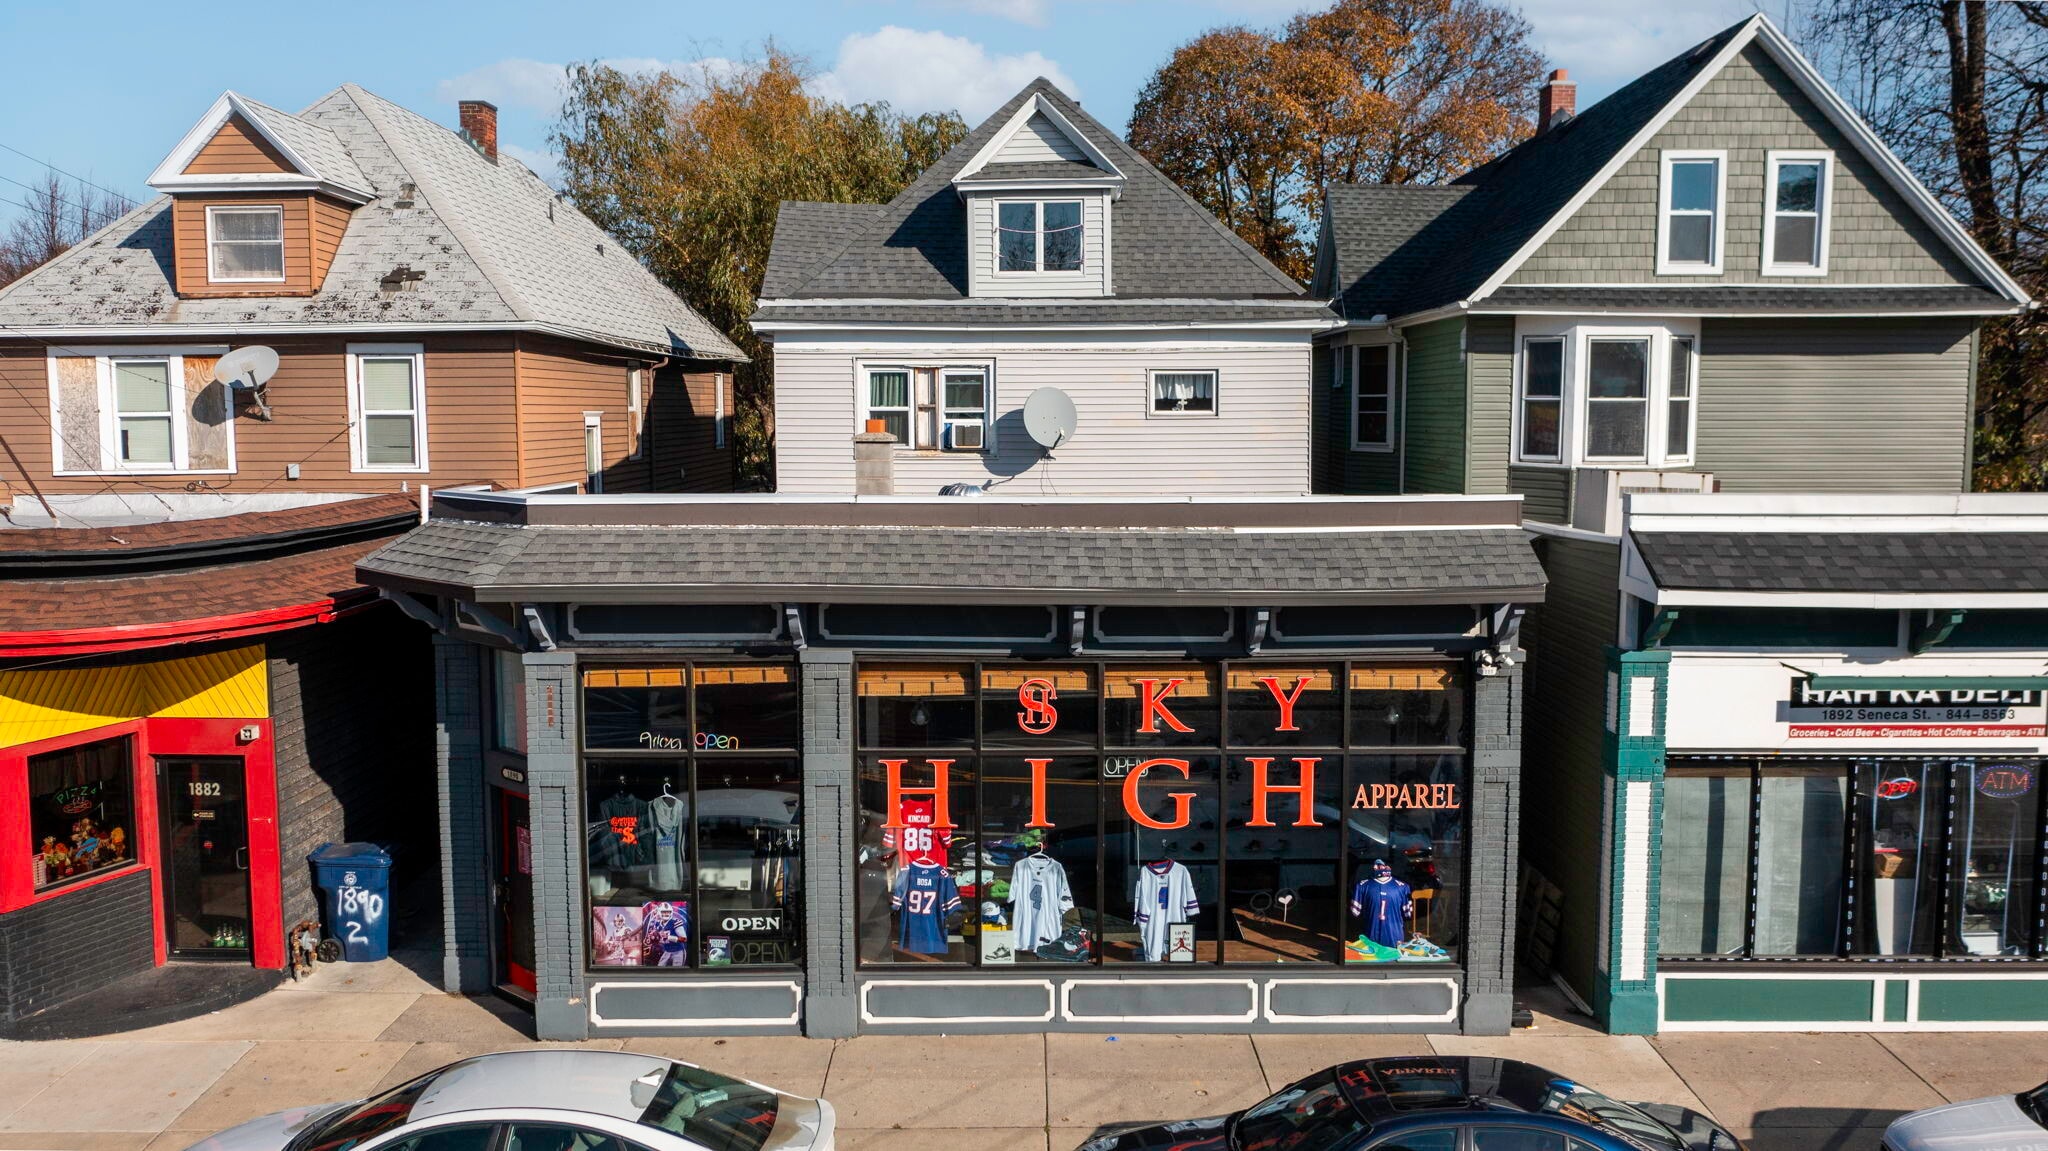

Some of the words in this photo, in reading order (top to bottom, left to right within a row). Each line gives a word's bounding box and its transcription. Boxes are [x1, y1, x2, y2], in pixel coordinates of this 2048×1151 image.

[1822, 709, 1853, 720] 1892
[1857, 708, 1908, 720] Seneca
[1912, 708, 1931, 720] St.
[1789, 727, 1830, 737] Groceries
[1835, 727, 1855, 737] Cold
[1855, 727, 1875, 737] Beer
[1880, 727, 1922, 738] Cigarettes
[1927, 727, 1944, 737] Hot
[1944, 727, 1972, 737] Coffee
[1977, 727, 2020, 738] Beverages
[2026, 727, 2045, 737] ATM
[188, 782, 221, 796] 1882
[1876, 780, 1918, 797] Open
[1982, 770, 2029, 791] ATM
[878, 757, 1323, 830] HIGH
[1352, 783, 1460, 809] APPAREL
[904, 827, 933, 851] 86
[916, 877, 933, 887] BOSA
[337, 888, 384, 925] 1890
[908, 890, 937, 915] 97
[345, 921, 369, 945] 2
[721, 916, 781, 932] OPEN
[731, 942, 788, 963] OPEN
